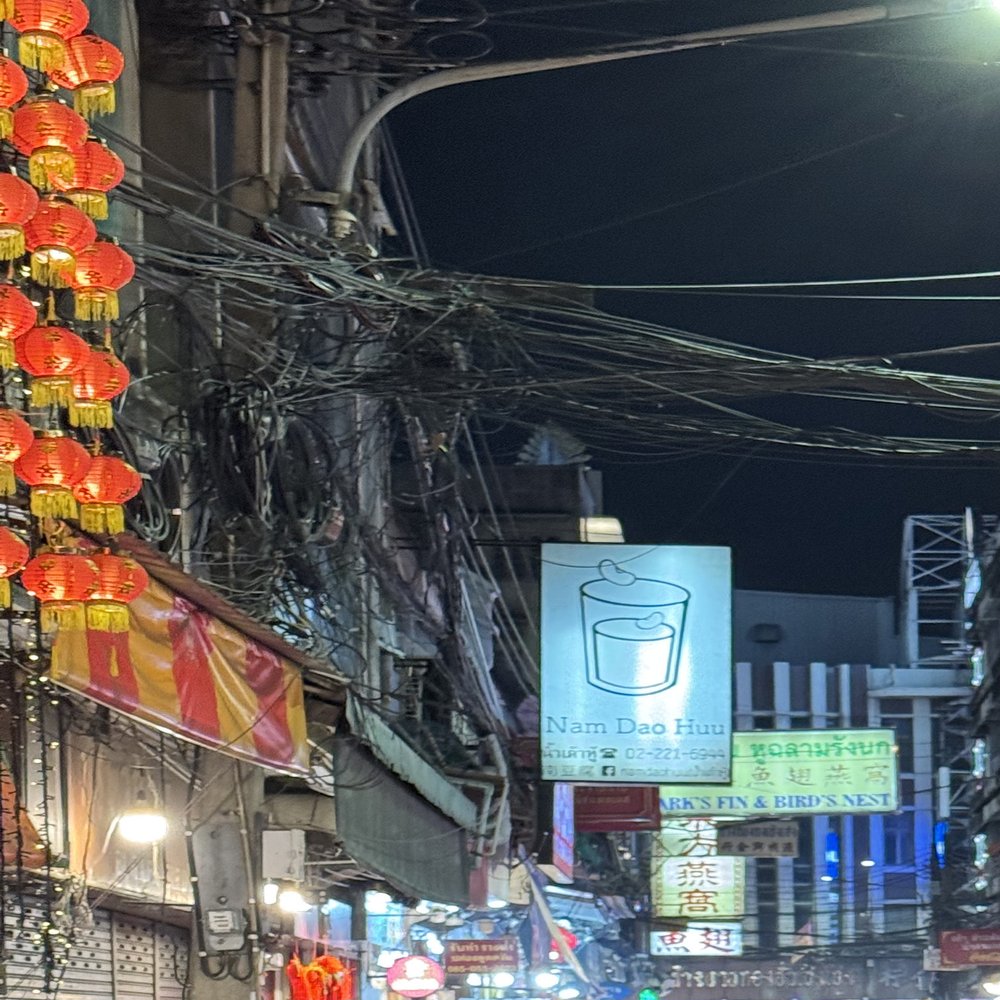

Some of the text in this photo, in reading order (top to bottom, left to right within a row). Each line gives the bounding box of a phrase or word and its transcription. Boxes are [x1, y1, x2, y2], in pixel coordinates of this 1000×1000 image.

[546, 716, 726, 736] Nam Dao Huu
[716, 795, 749, 809] FIN
[753, 795, 769, 809] &
[774, 794, 837, 809] BIRD'S
[843, 792, 891, 807] NEST
